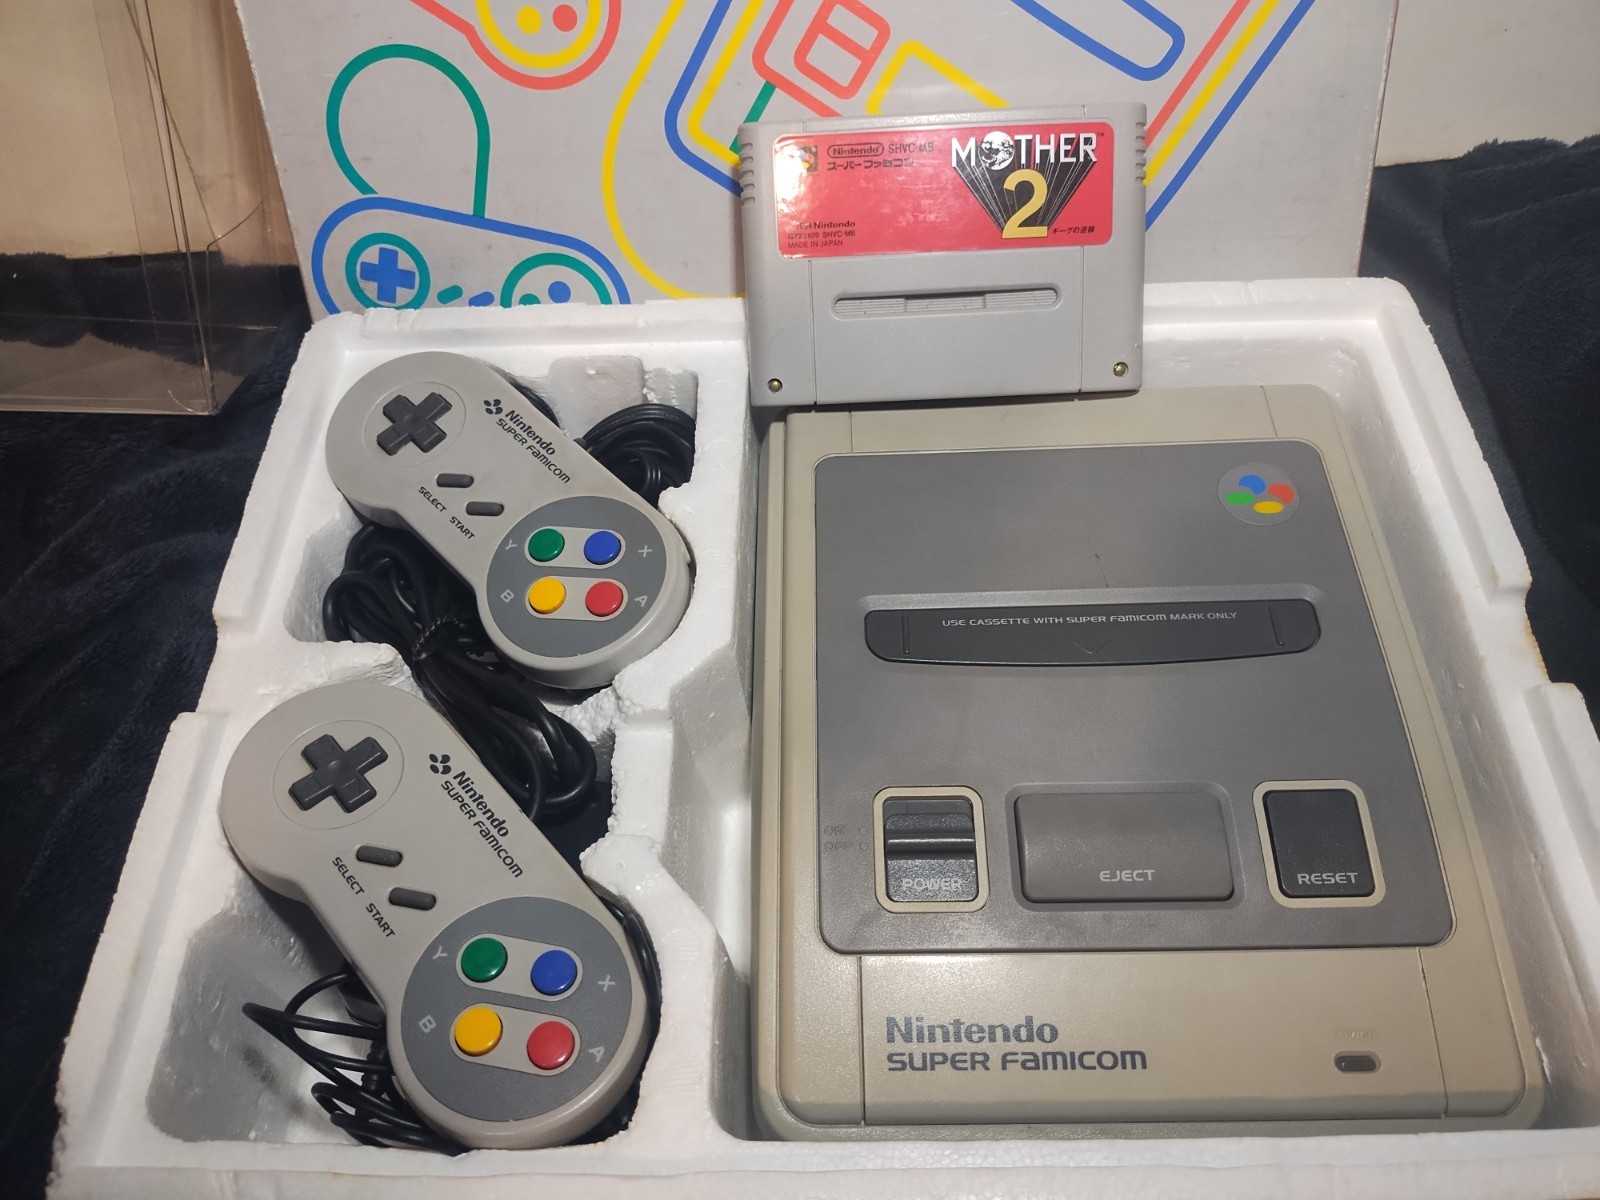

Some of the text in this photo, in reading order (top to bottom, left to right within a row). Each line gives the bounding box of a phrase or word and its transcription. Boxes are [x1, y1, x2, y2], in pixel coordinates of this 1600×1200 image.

[951, 130, 1097, 170] MOTHER
[1001, 168, 1049, 239] 2
[813, 220, 856, 229] Nintendo
[787, 239, 844, 249] MADE IN JAPAN
[495, 418, 528, 445] SUPER
[504, 409, 556, 455] Nintendo
[417, 486, 447, 513] SELECT
[449, 516, 476, 540] START
[505, 540, 518, 551] Y
[638, 545, 653, 558] X
[501, 589, 515, 603] B
[634, 593, 649, 607] A
[942, 619, 966, 627] USE
[969, 617, 1030, 626] CASSETTE
[1033, 616, 1063, 624] WITH
[1066, 615, 1107, 624] SUPER
[1169, 612, 1204, 621] MARK
[1207, 611, 1238, 620] ONLY
[441, 780, 477, 820] SUPER
[453, 770, 509, 837] Nintendo
[332, 856, 365, 896] SELECT
[901, 877, 962, 891] POWER
[1099, 869, 1155, 883] EJECT
[1296, 872, 1358, 886] RESET
[365, 902, 396, 938] START
[432, 945, 448, 961] Y
[597, 975, 616, 991] X
[418, 1015, 437, 1033] B
[886, 1016, 1059, 1045] Nintendo
[587, 1045, 606, 1062] A
[886, 1051, 990, 1072] SUPER
